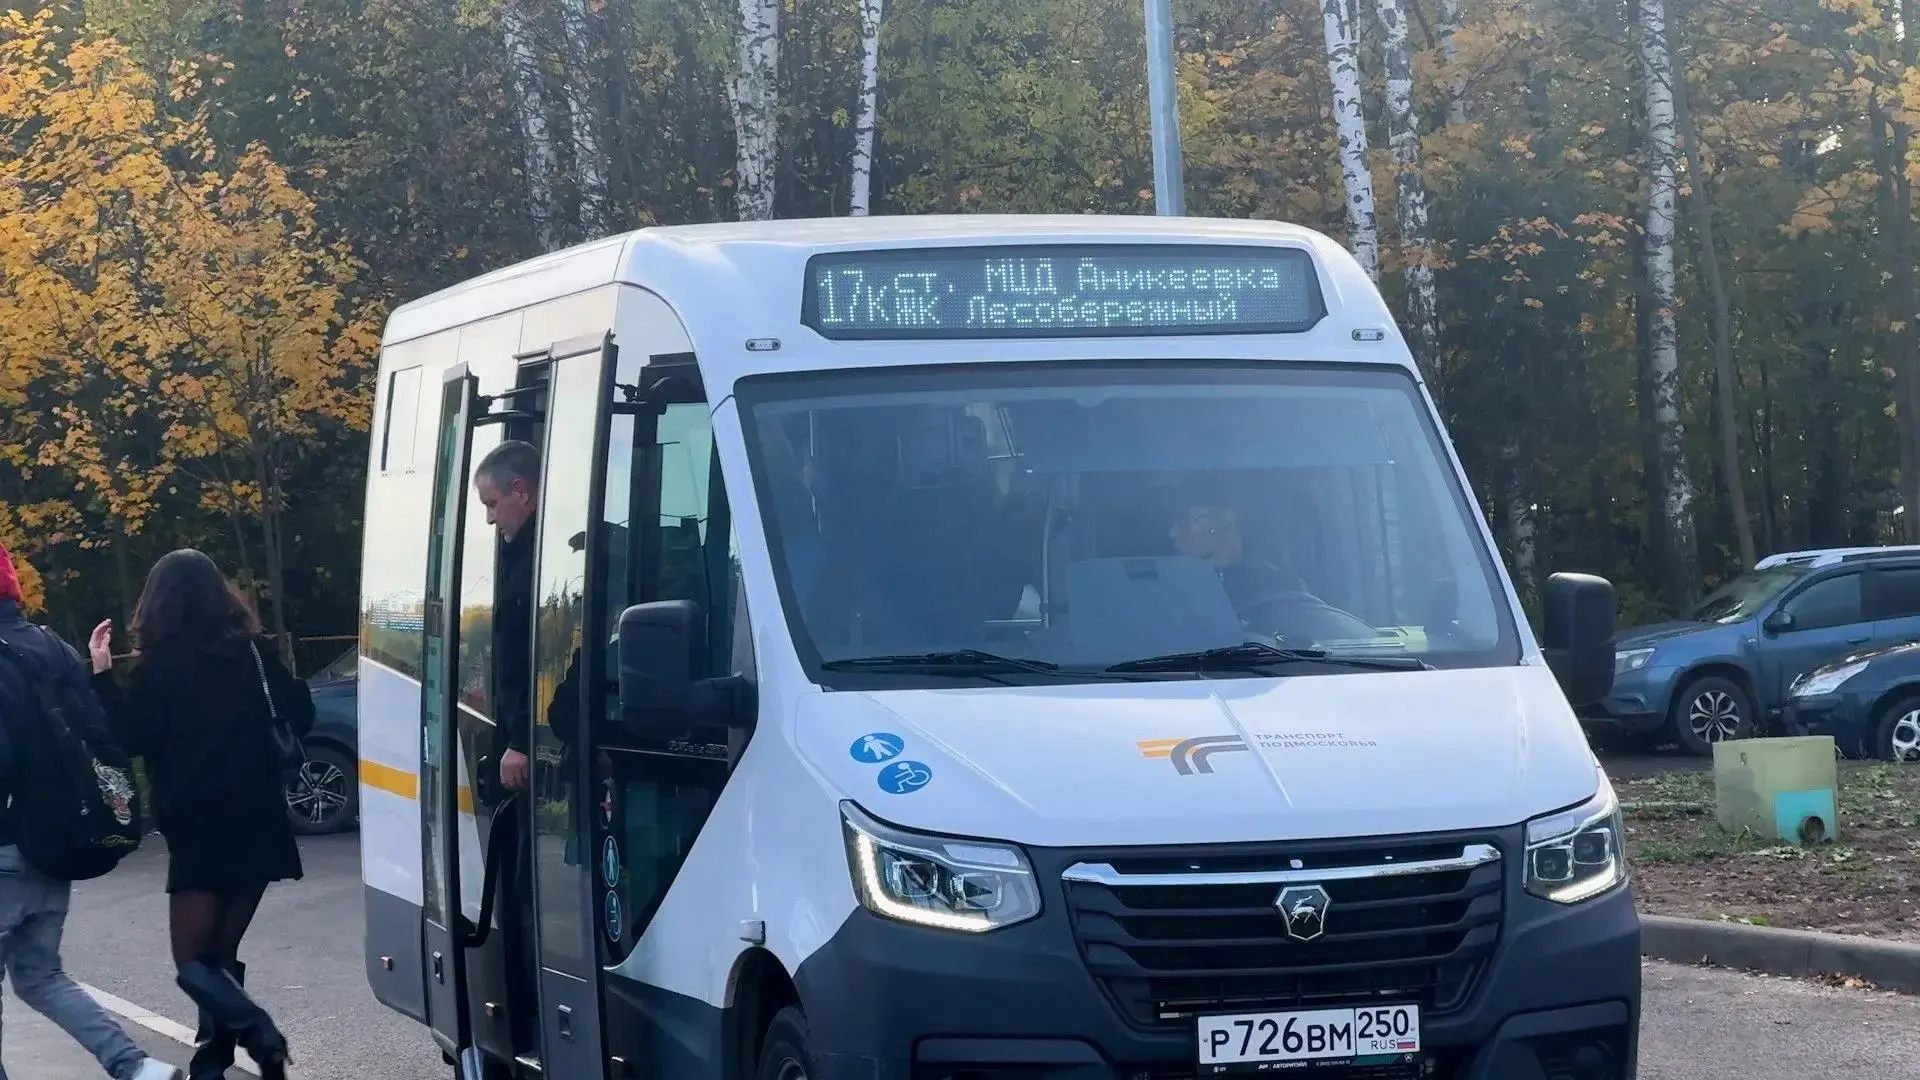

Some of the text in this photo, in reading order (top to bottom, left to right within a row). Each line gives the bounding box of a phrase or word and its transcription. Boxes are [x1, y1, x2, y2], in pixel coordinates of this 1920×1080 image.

[1078, 261, 1279, 291] Аникеевка
[966, 290, 1238, 326] Лесобережный
[1260, 740, 1378, 748] ПОДМОСКОВЬЯ
[1358, 1009, 1410, 1039] 250
[1370, 1039, 1397, 1051] RUS
